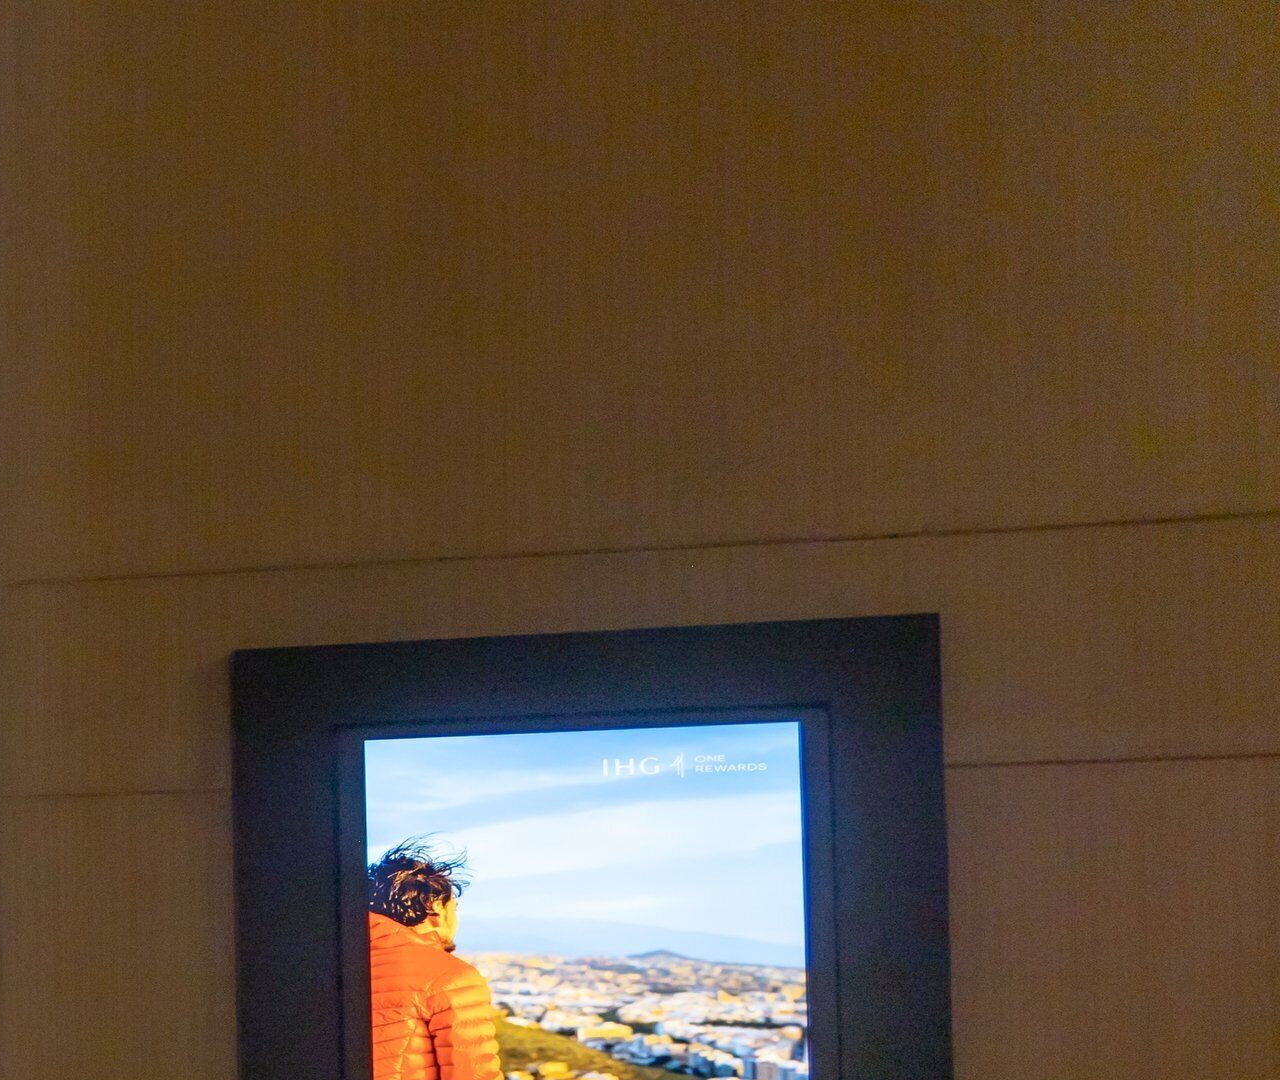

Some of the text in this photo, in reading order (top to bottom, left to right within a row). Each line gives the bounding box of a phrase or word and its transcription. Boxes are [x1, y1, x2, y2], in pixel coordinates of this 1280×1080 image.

[694, 754, 726, 763] ONE
[602, 757, 660, 777] IHG
[695, 762, 768, 773] REWARDS
